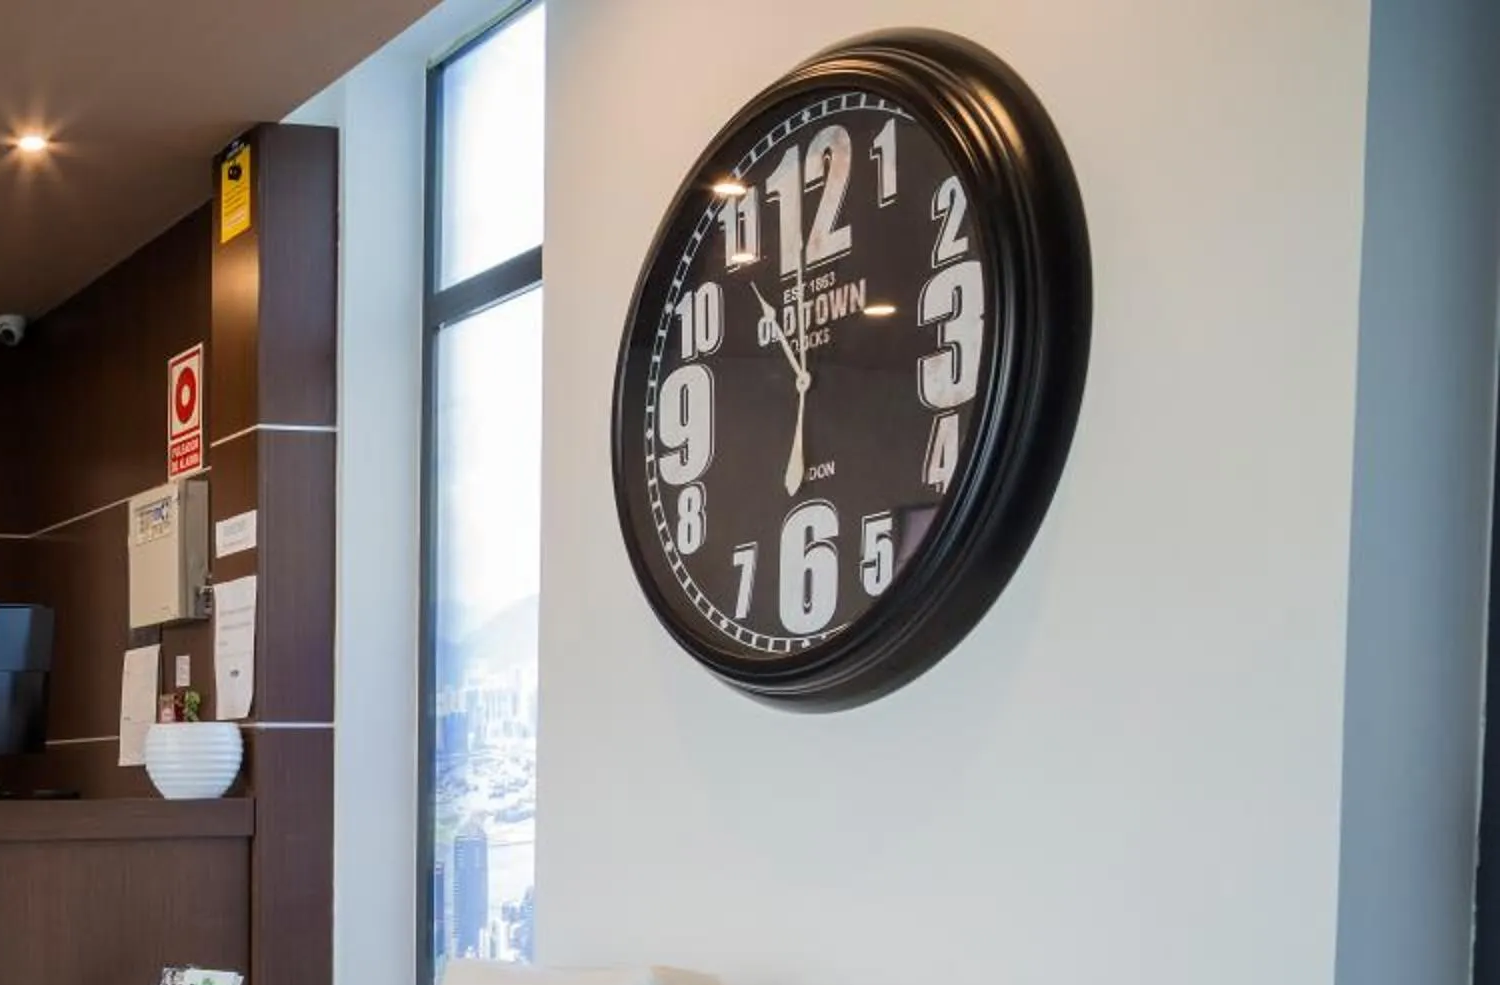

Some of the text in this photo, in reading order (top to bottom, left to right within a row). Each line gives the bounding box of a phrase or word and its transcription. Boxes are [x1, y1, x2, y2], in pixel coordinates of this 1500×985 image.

[766, 124, 852, 281] 12
[870, 118, 898, 207] 1
[717, 186, 761, 274] 11
[931, 175, 969, 268] 2
[675, 280, 723, 360] 10
[916, 259, 985, 410] 3
[656, 363, 716, 487] 9
[921, 409, 963, 496] 4
[676, 481, 707, 556] 8
[859, 510, 894, 598] 5
[732, 541, 758, 620] 7
[778, 499, 840, 637] 6
